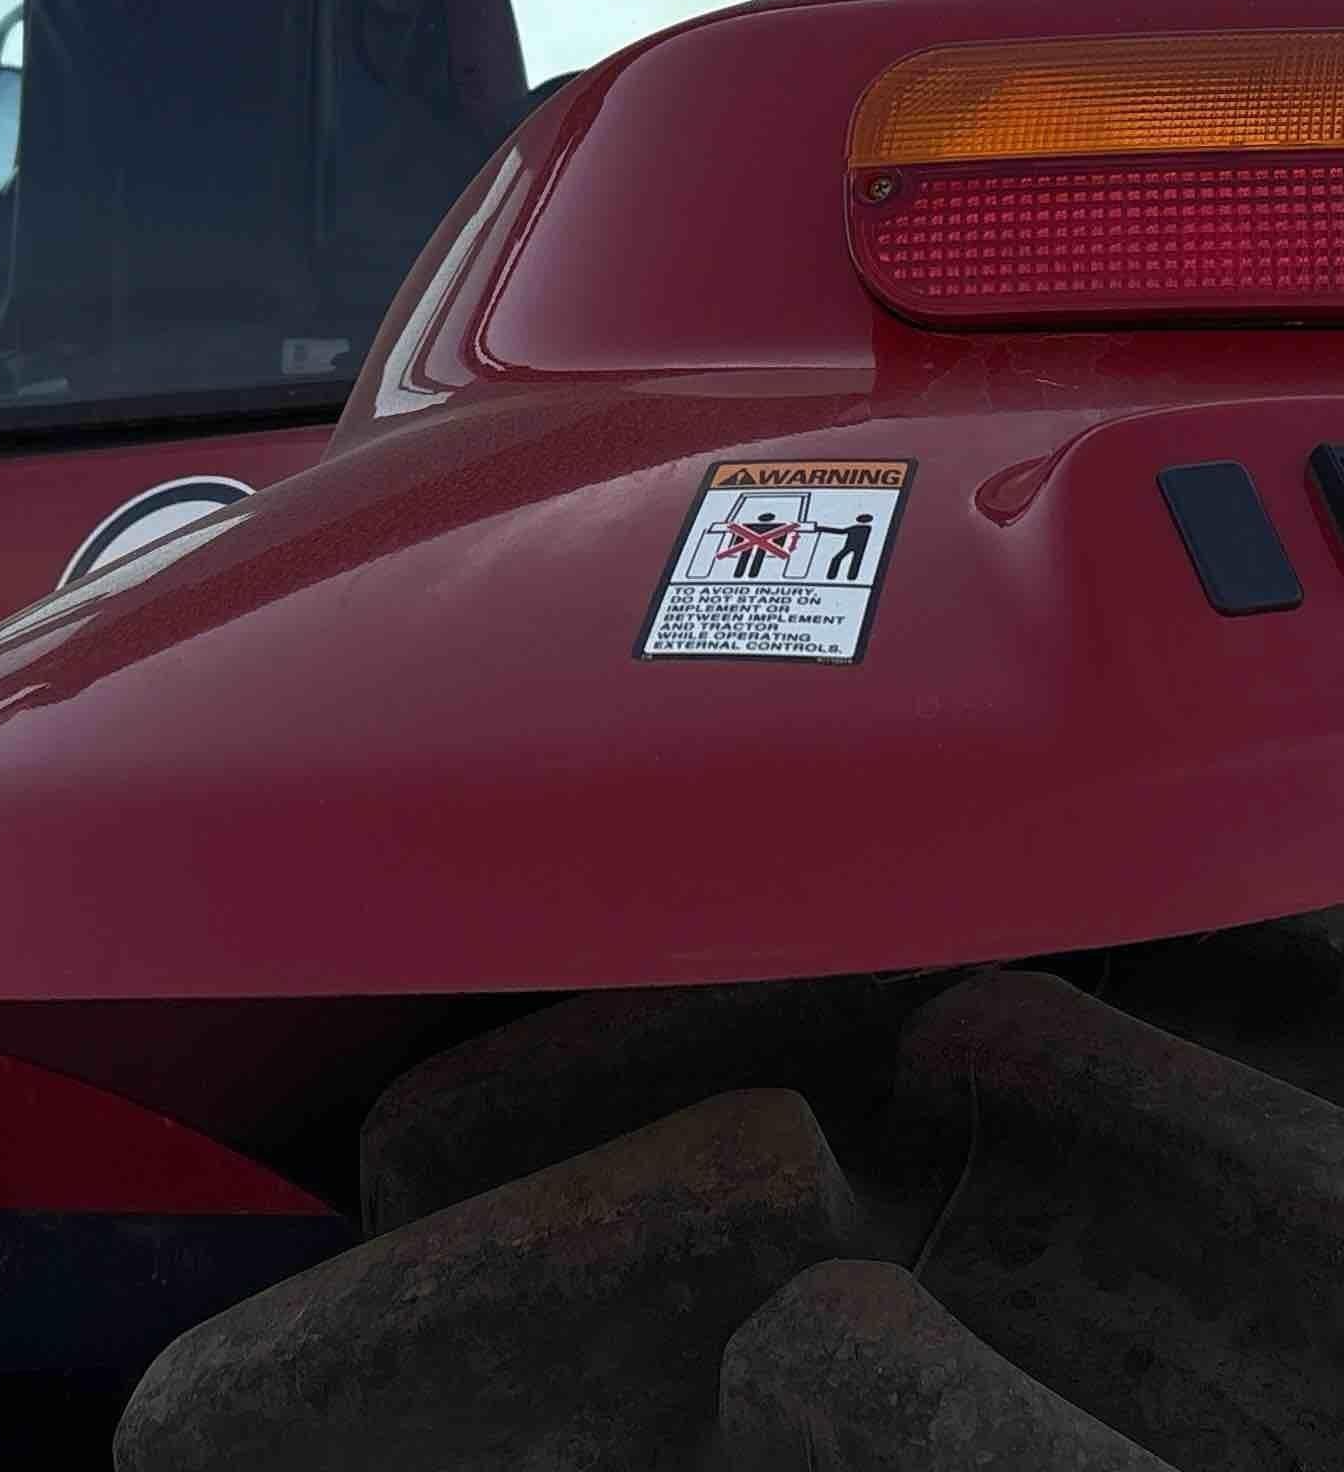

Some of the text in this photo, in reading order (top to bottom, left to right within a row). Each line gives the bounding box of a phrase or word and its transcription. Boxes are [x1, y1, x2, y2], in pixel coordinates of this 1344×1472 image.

[758, 469, 902, 486] WARNING
[674, 587, 696, 596] TO
[699, 587, 750, 596] AVOID
[670, 596, 822, 606] DO NOT STAND ON
[666, 604, 791, 614] IMPLEMENT OR
[663, 613, 846, 625] BETWEEN IMPLEMENT
[659, 623, 779, 632] AND TRACTOR
[657, 632, 811, 642] WHILE OPERATING
[653, 641, 843, 654] EXTERNAL CONTROLS.
